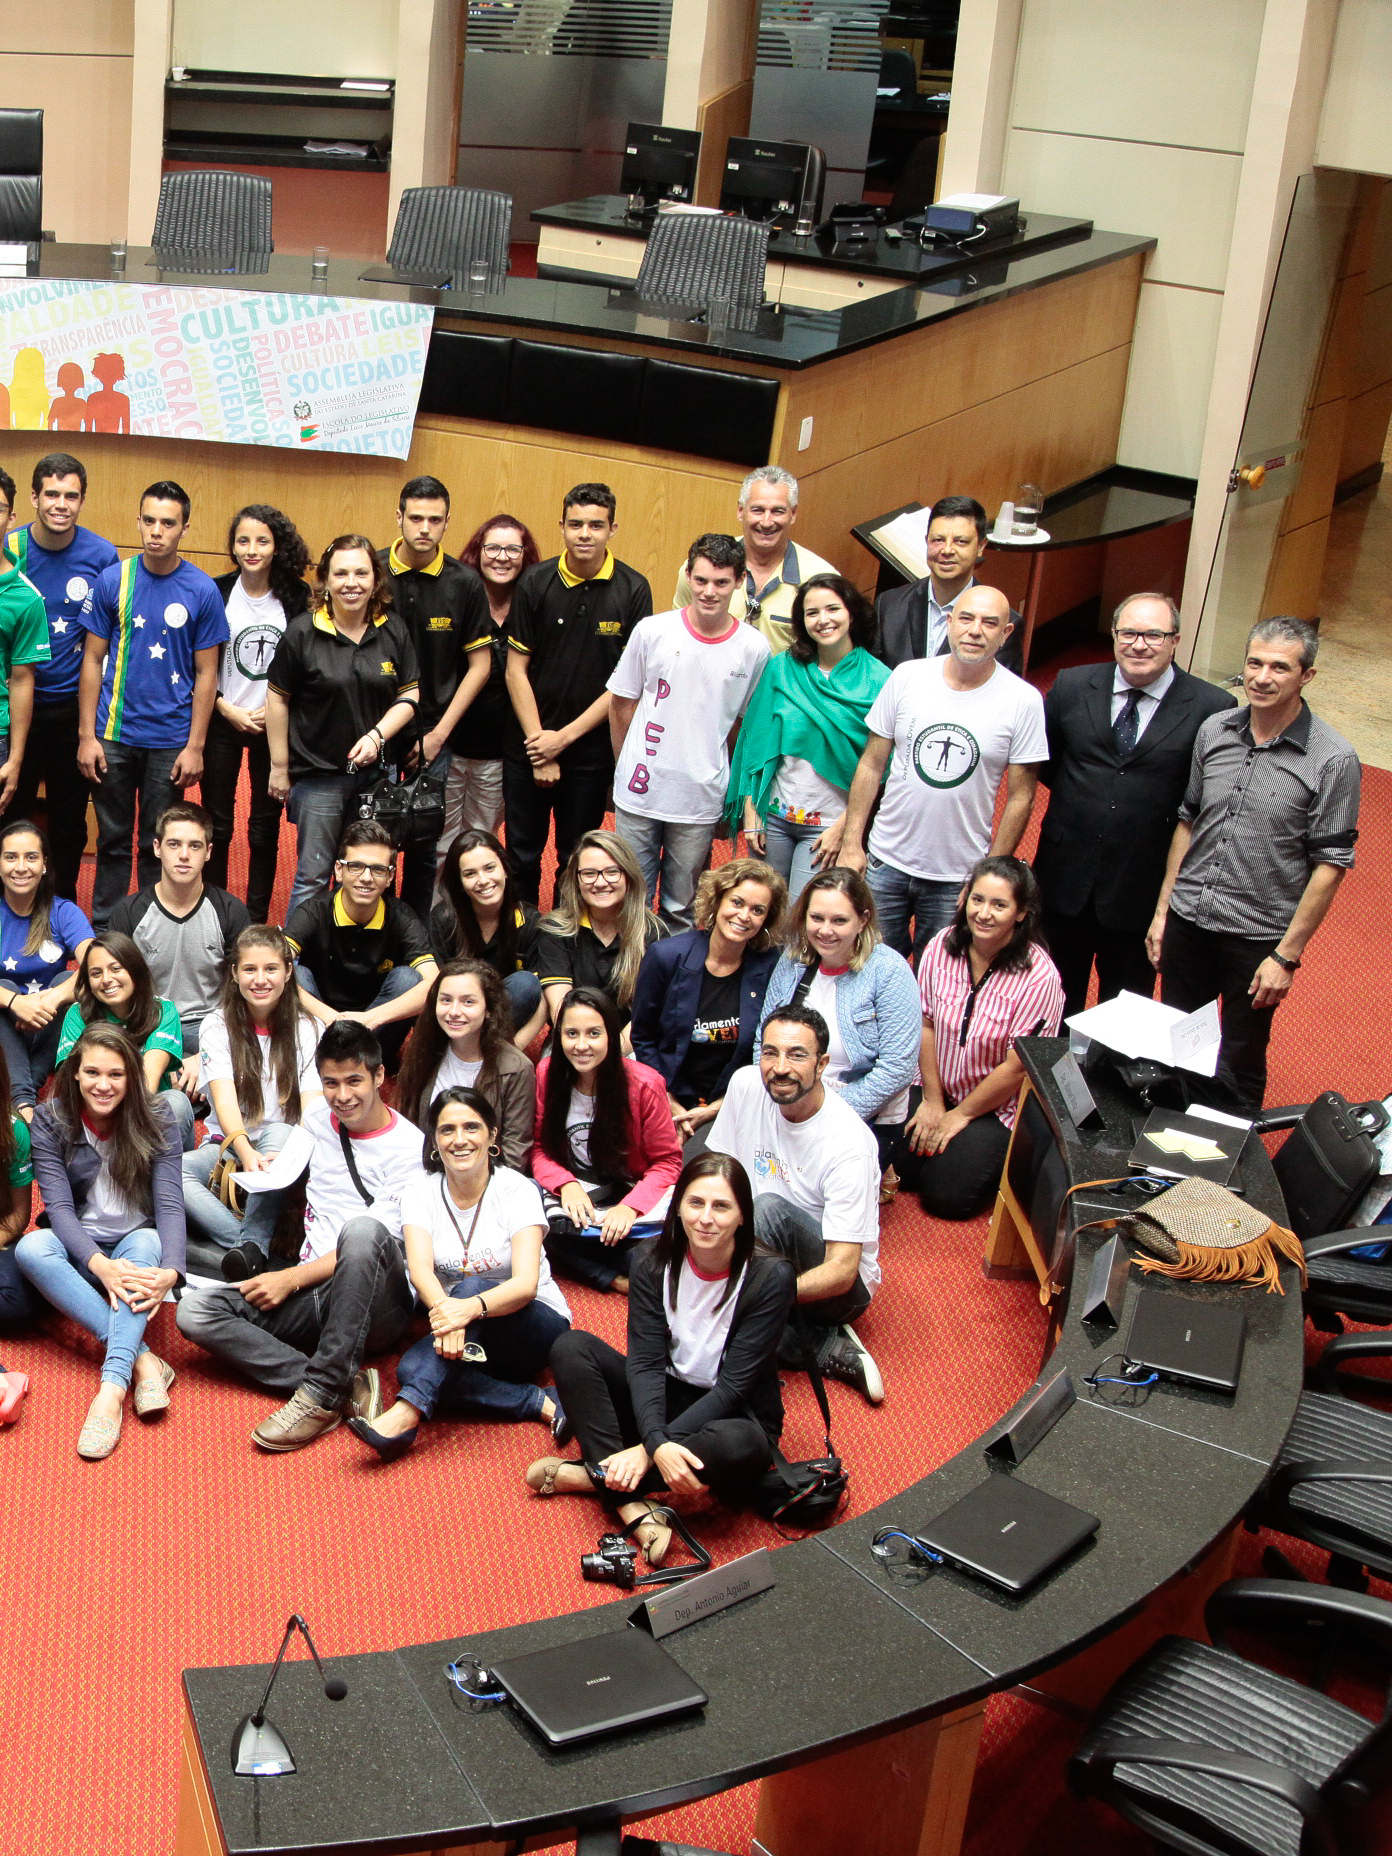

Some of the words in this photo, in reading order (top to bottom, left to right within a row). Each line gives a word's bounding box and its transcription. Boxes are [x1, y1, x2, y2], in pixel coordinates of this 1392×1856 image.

[180, 292, 341, 345] CULTURA
[273, 311, 370, 354] DEBATE
[280, 341, 360, 374] CULTURA
[360, 327, 421, 358] LEIS
[287, 350, 423, 398] SOCIEDADE
[314, 393, 357, 407] ASSEMBLEIA
[358, 383, 406, 398] LEGISLATIVA
[322, 418, 351, 429] ESCOLA
[351, 414, 363, 423] DO
[364, 404, 410, 421] LEGISLATIVO
[325, 404, 347, 413] ESTADO
[357, 397, 377, 406] SANTA
[377, 391, 407, 402] CATARINA
[674, 1608, 694, 1622] Dep.
[726, 1580, 752, 1600] Aguiar
